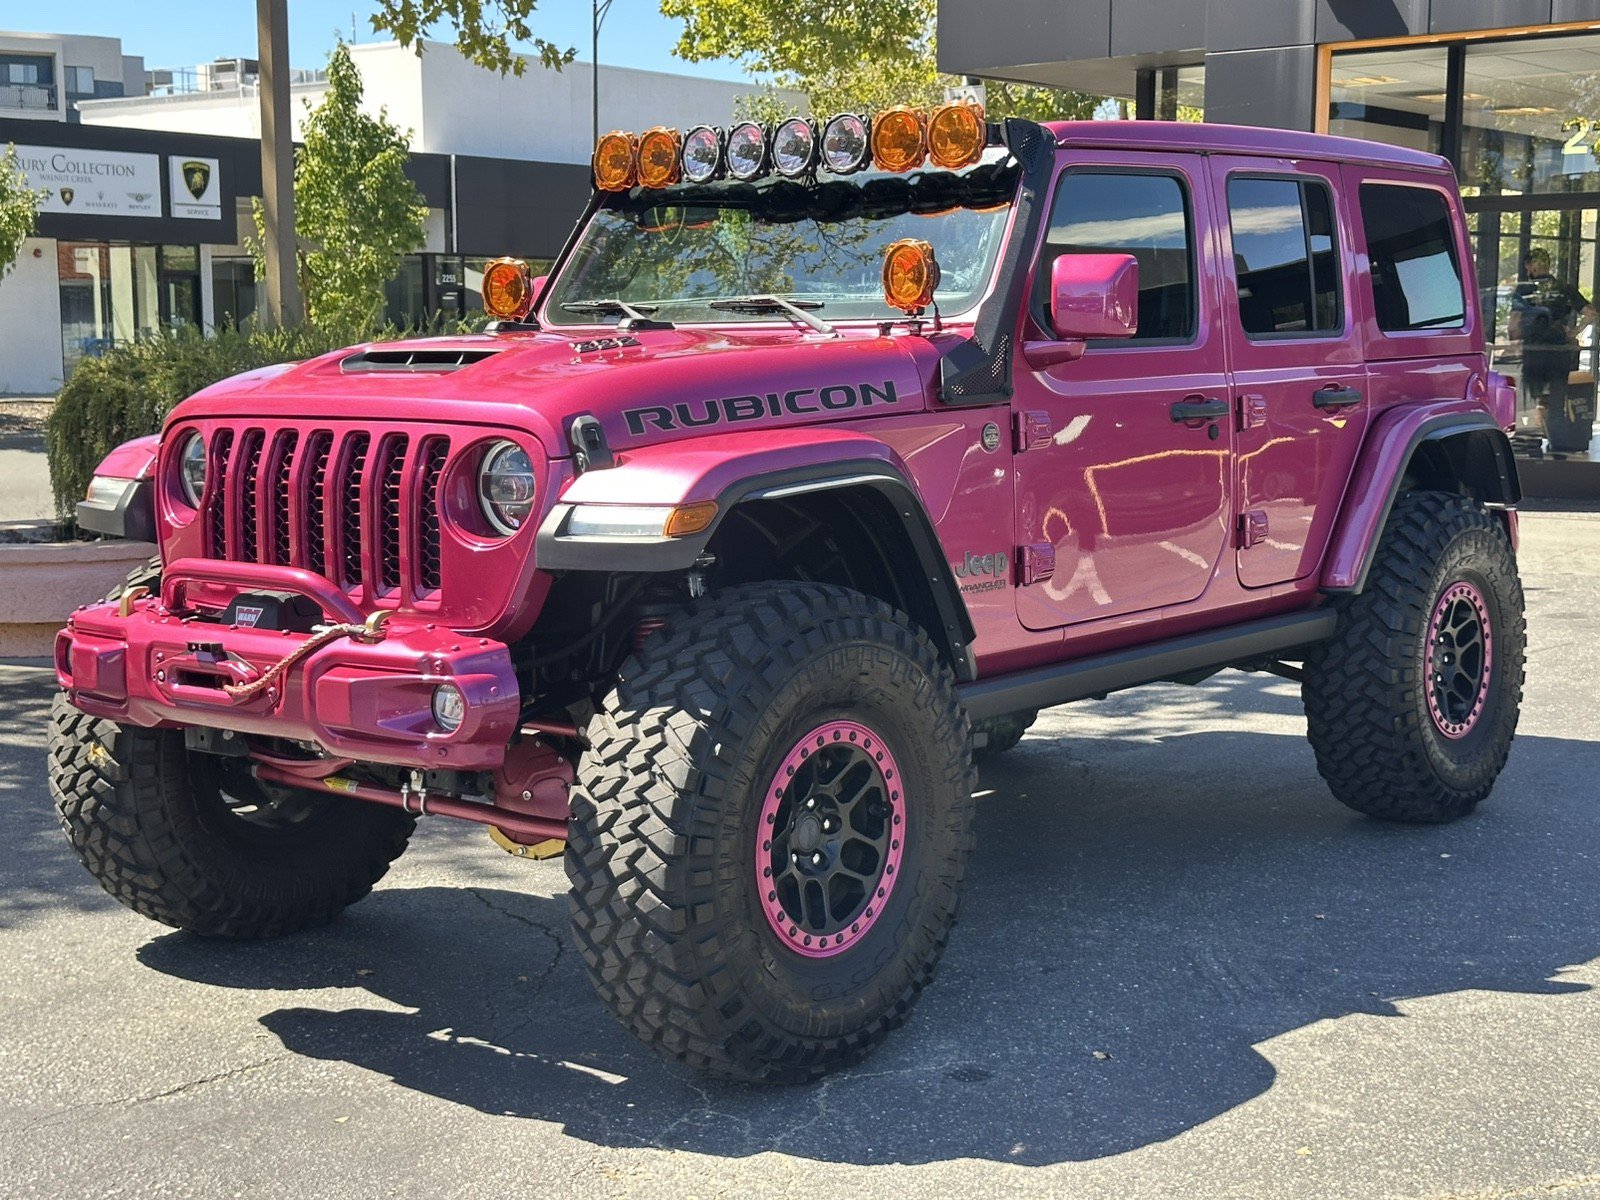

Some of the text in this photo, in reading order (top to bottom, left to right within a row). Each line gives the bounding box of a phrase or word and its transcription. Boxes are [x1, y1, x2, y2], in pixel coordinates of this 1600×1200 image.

[51, 154, 136, 177] COLLECTION
[39, 173, 94, 184] WALNUT CREEK
[441, 274, 457, 283] 2255
[621, 379, 898, 436] RUBICON
[955, 550, 1009, 578] Jeep
[960, 579, 1006, 592] WRANGLER
[237, 612, 257, 622] WARN
